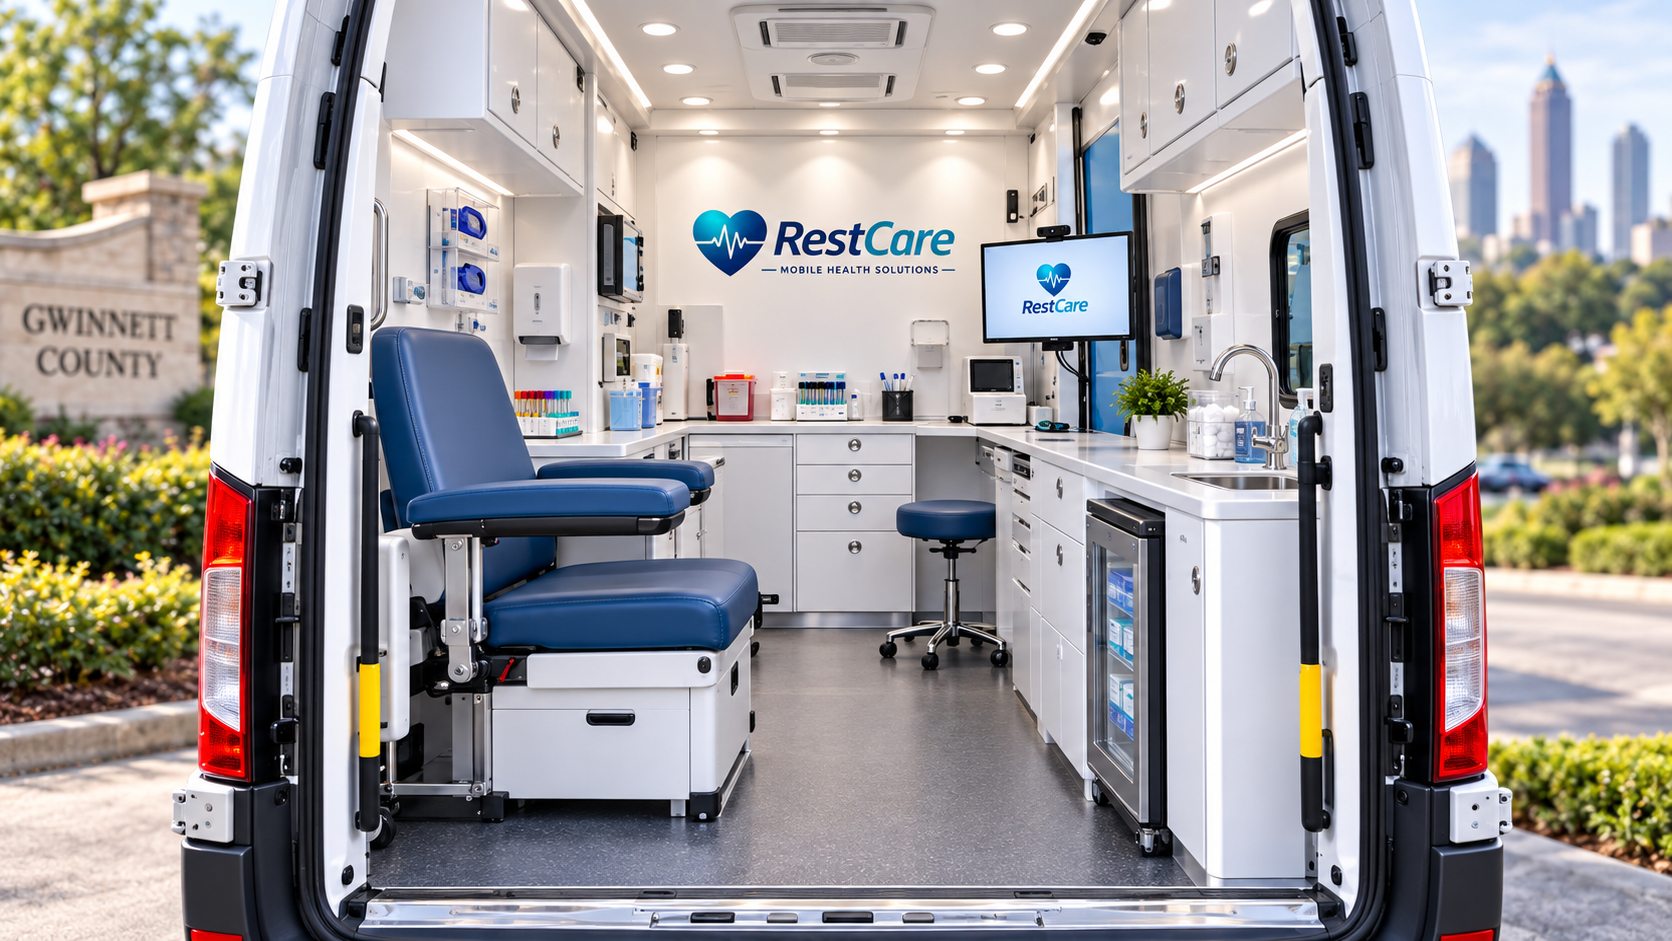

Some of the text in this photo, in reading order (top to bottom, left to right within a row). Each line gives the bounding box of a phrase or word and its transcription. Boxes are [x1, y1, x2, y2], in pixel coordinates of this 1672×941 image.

[774, 221, 955, 256] RestCare
[780, 265, 939, 275] MOBILE HEALTH SOLUTIONS
[22, 303, 178, 341] GWINNETT
[1021, 298, 1089, 314] RestCare
[36, 346, 162, 378] COUNTY
